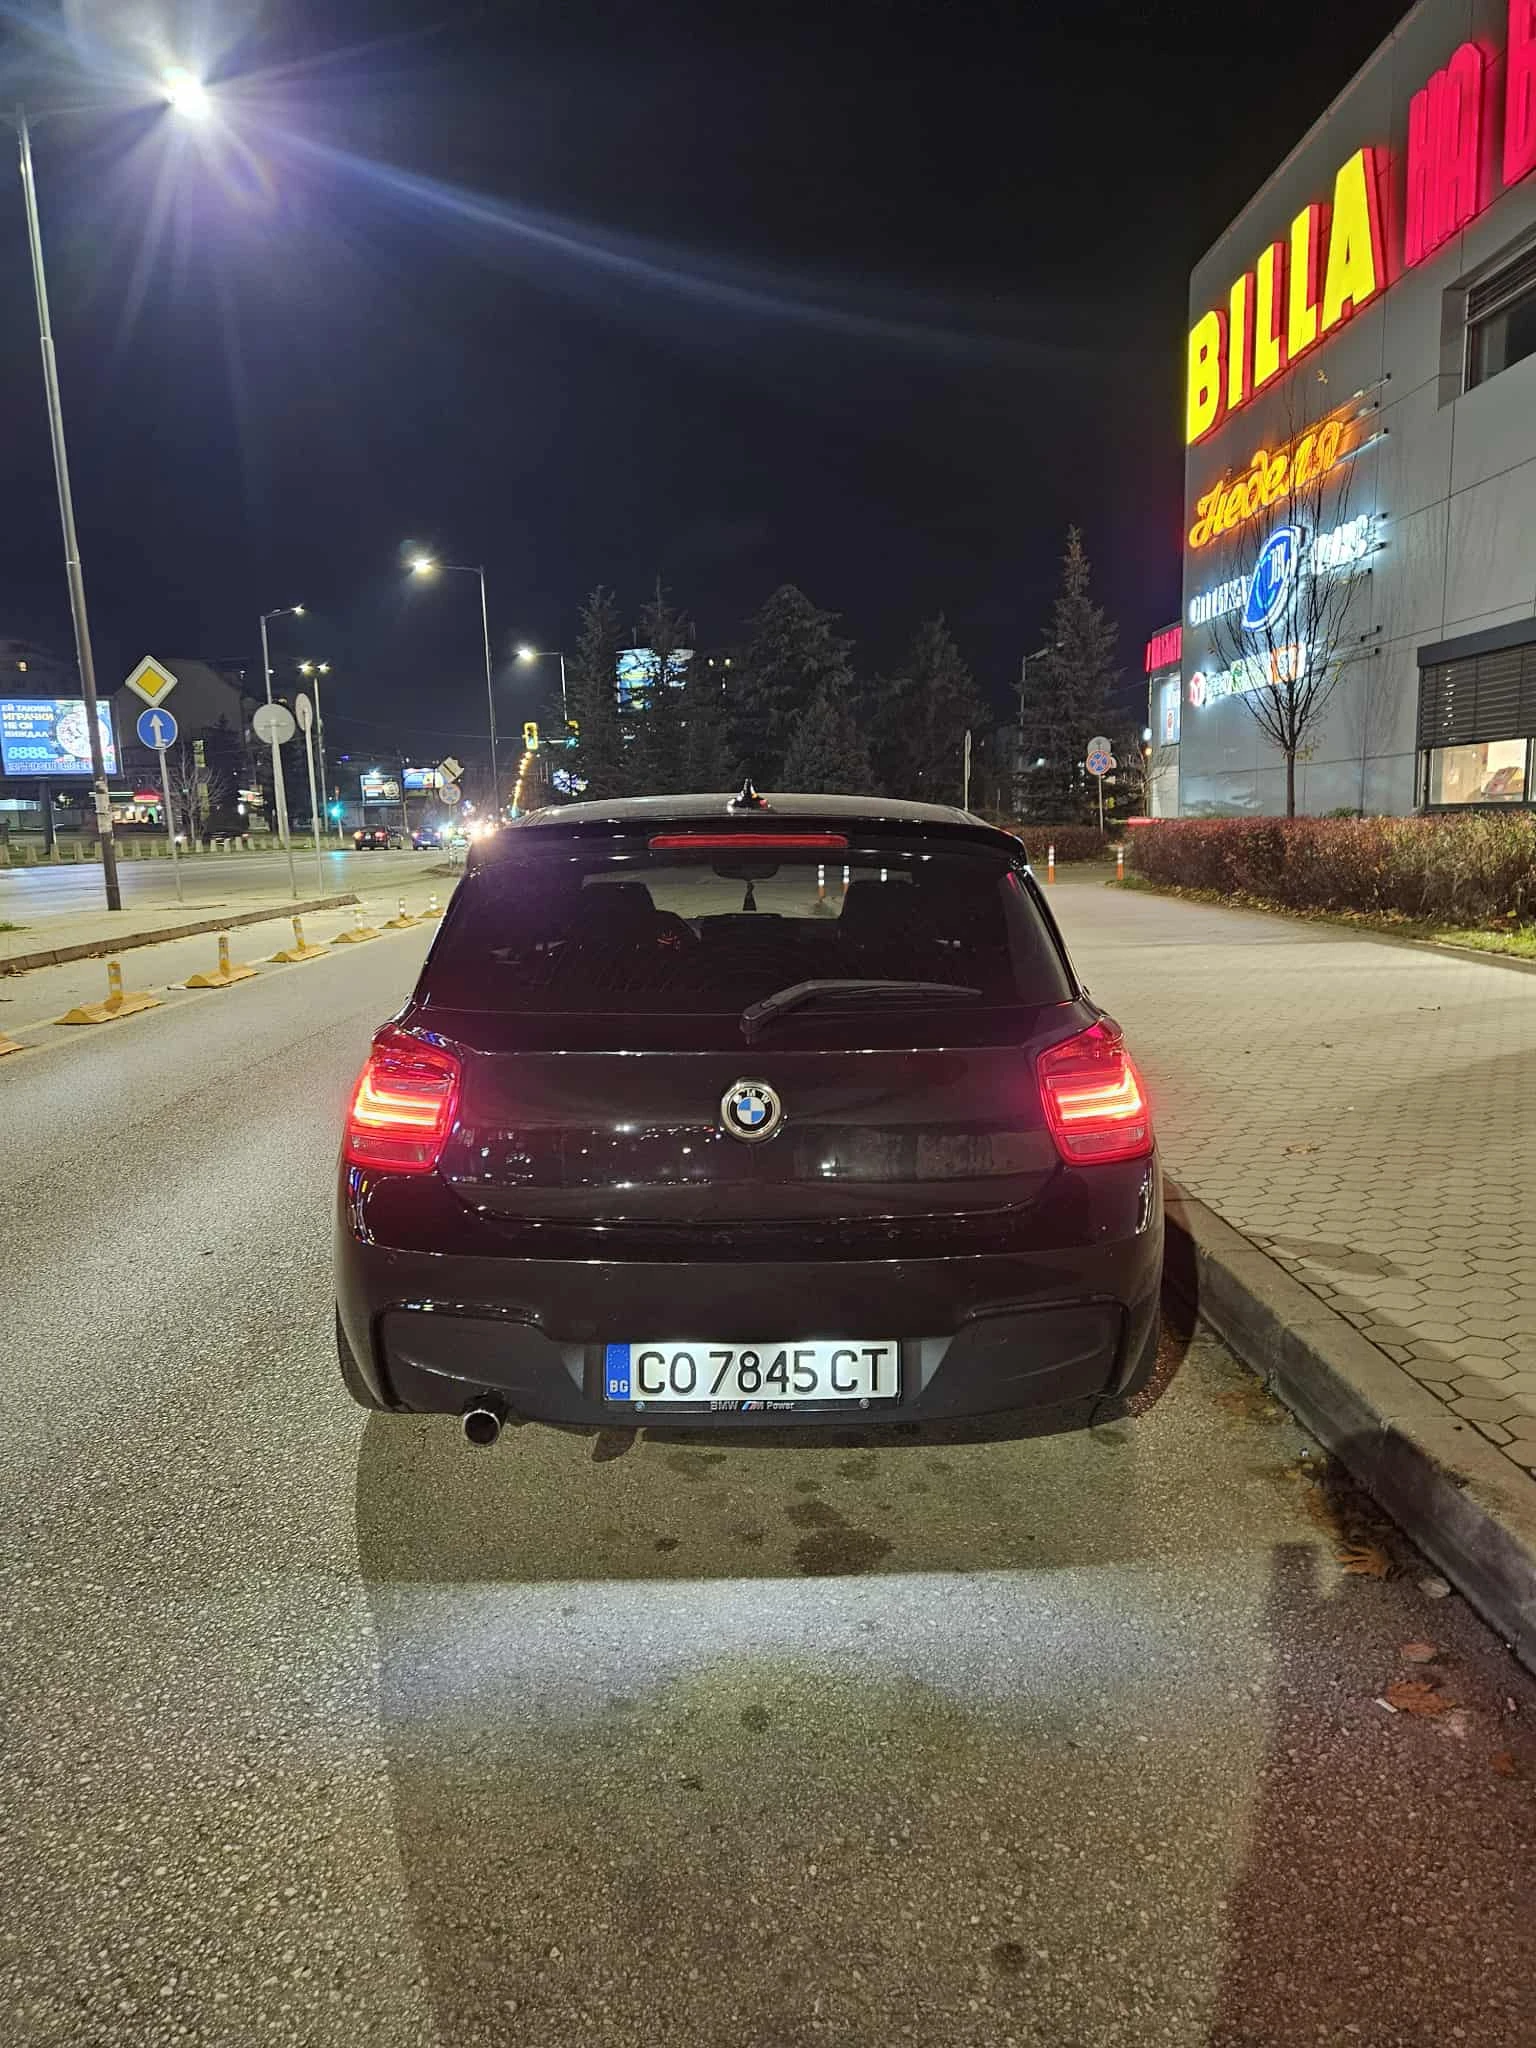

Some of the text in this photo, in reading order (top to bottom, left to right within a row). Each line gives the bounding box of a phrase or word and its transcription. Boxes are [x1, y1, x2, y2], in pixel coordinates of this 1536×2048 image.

[1187, 148, 1382, 445] BILLA
[3, 712, 55, 721] ИГРАЧКИ
[733, 1088, 770, 1104] BMW
[638, 1348, 888, 1394] CO 7845 CT
[609, 1380, 629, 1393] BG
[710, 1401, 738, 1410] BMW
[766, 1401, 794, 1410] Power
